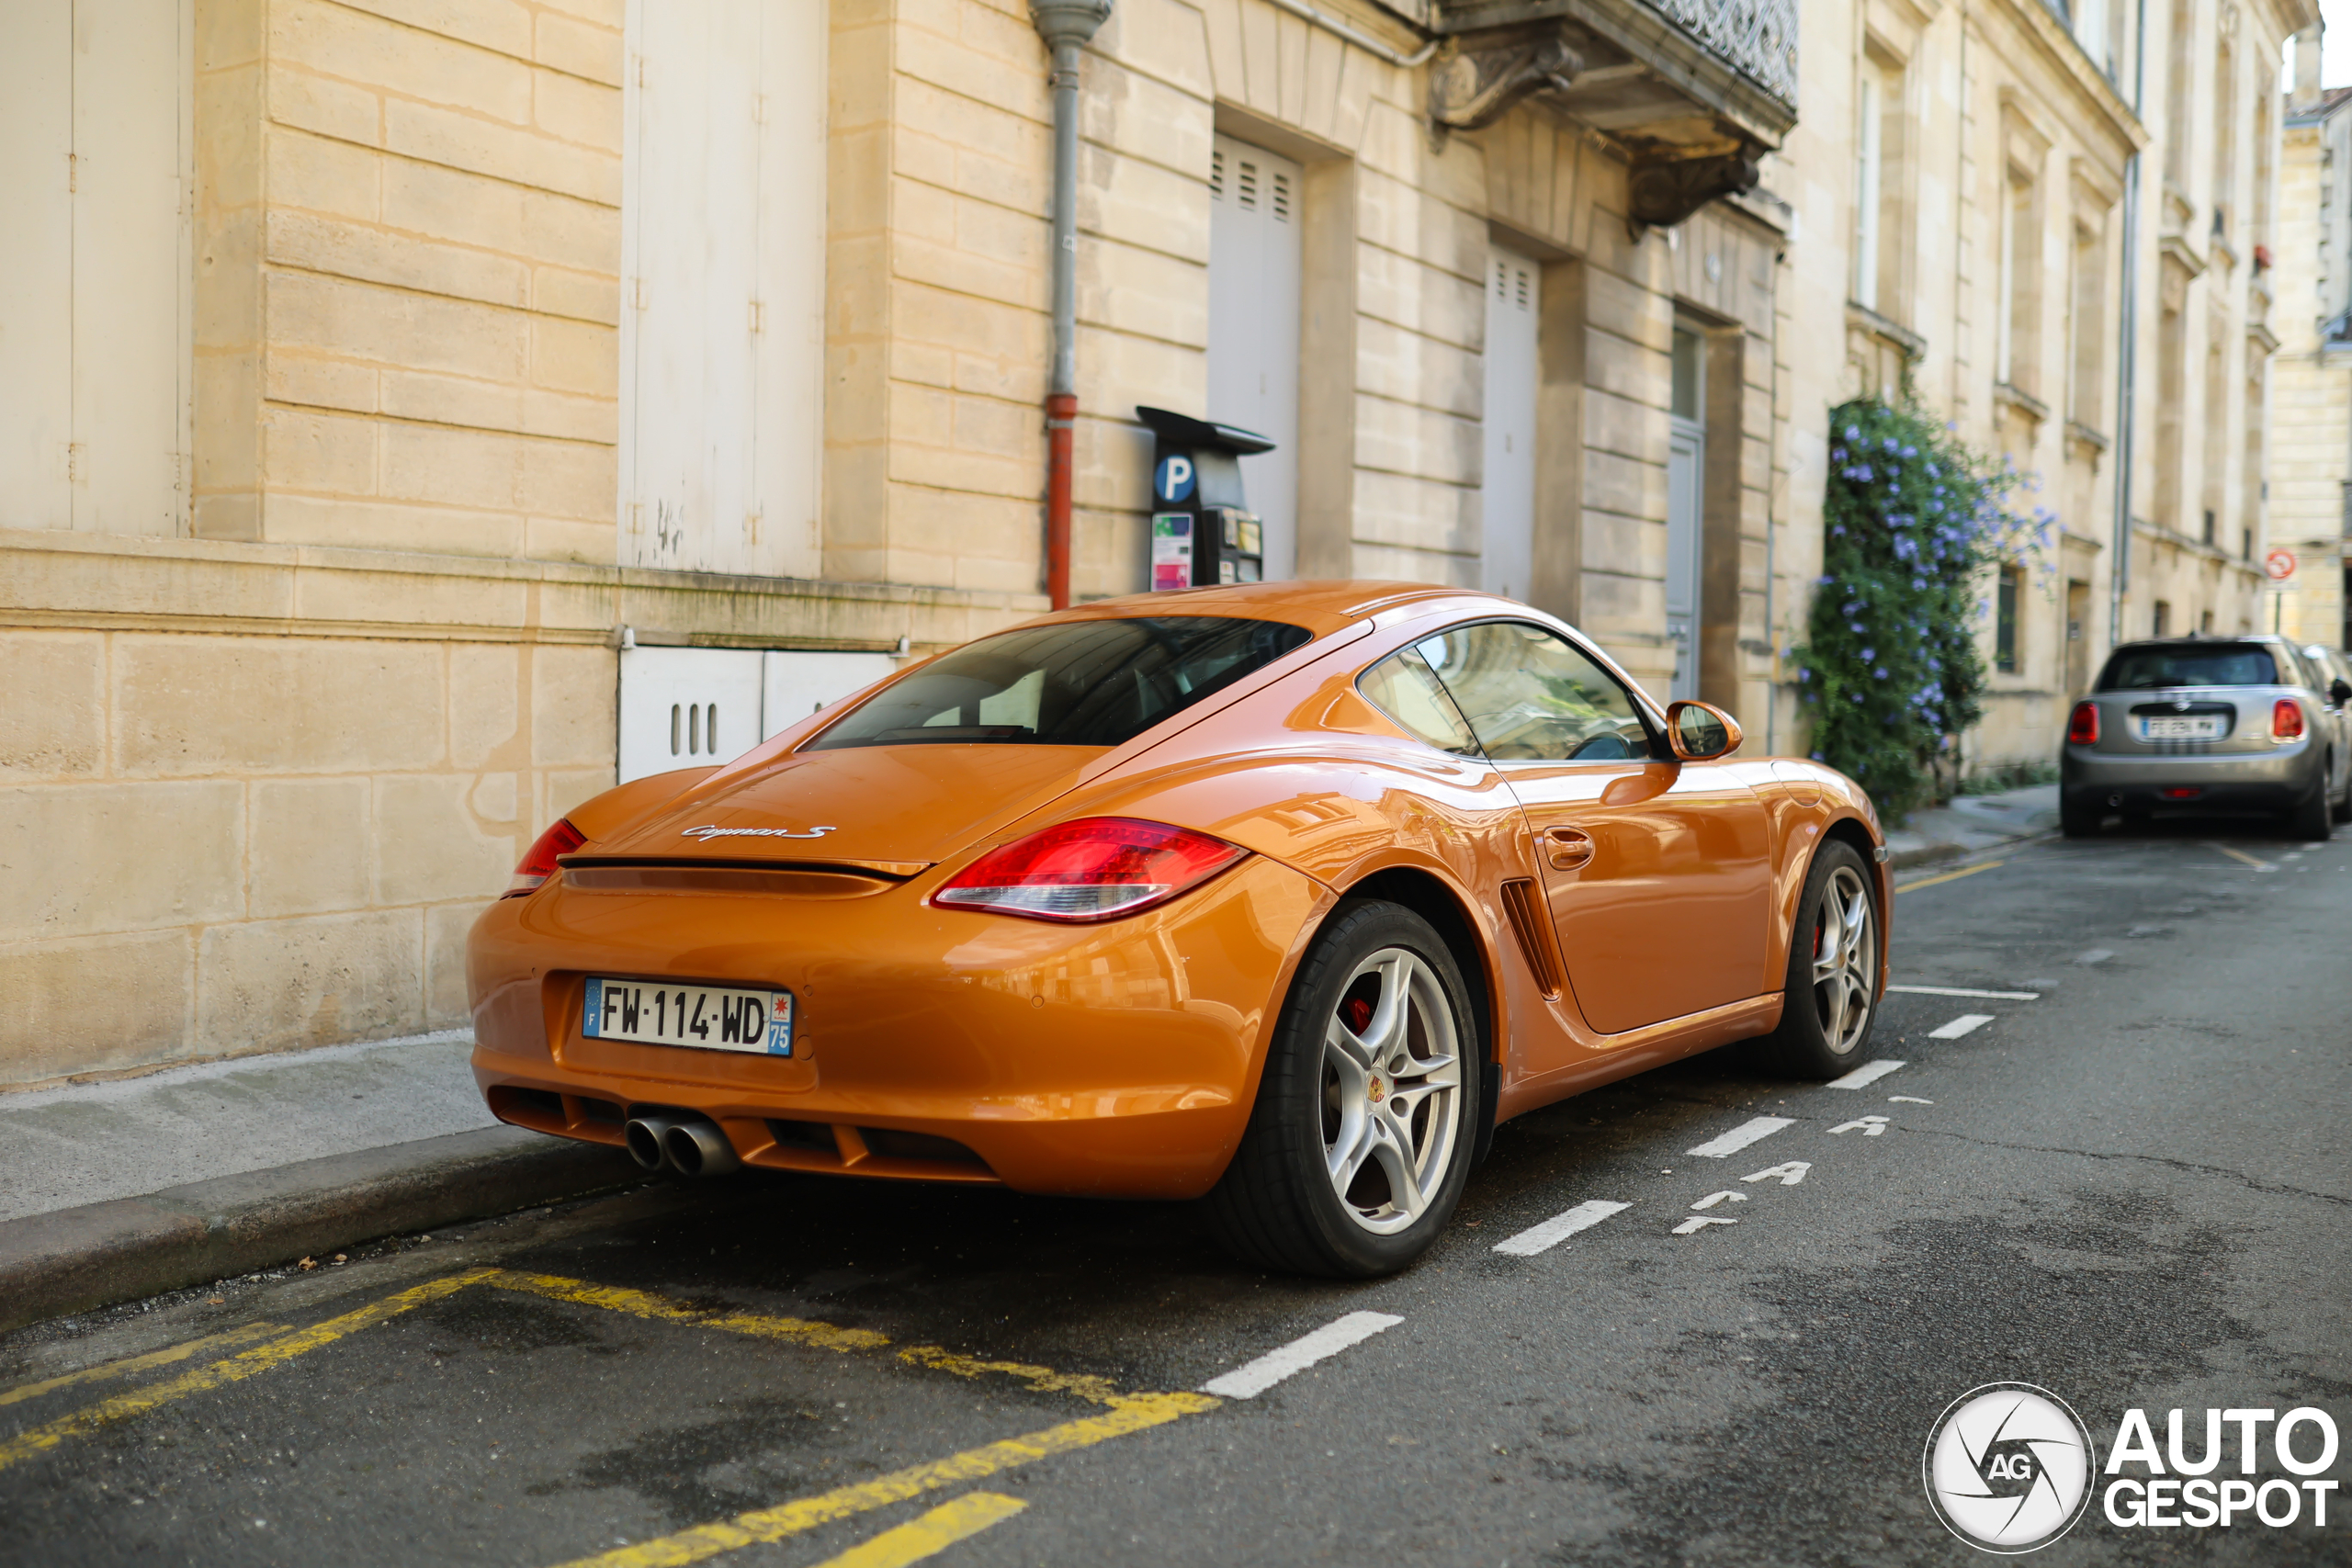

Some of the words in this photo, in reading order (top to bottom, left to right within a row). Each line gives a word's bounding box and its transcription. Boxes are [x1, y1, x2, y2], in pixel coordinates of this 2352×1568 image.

[1165, 457, 1193, 500] P
[681, 825, 787, 842] Cayman
[790, 826, 837, 838] S
[588, 1013, 595, 1026] F
[770, 1024, 788, 1049] 75
